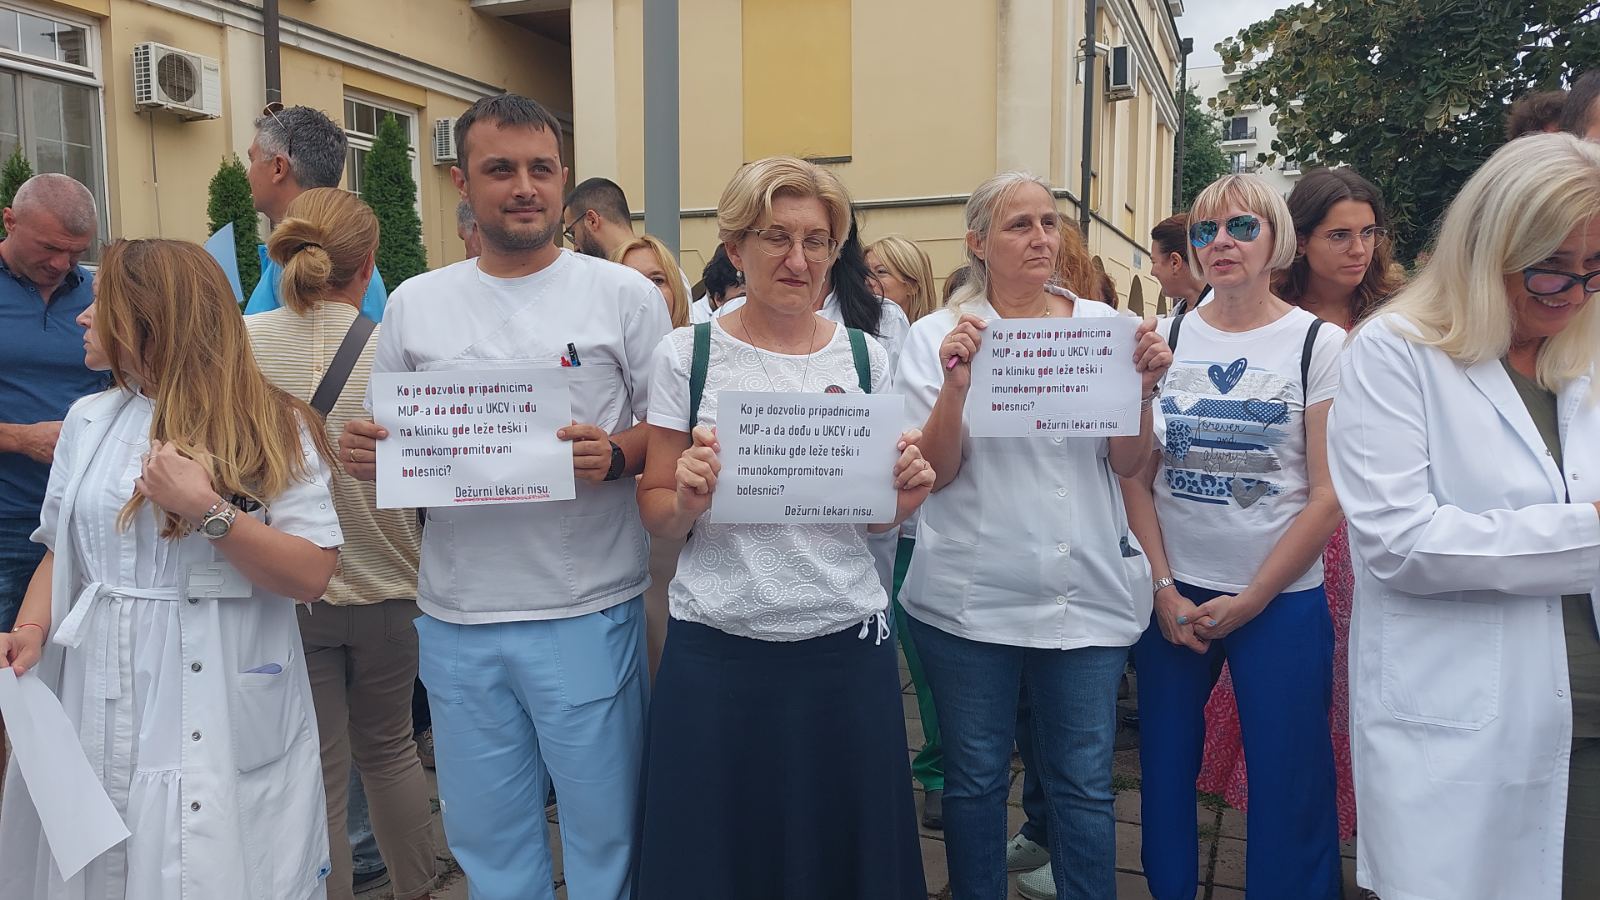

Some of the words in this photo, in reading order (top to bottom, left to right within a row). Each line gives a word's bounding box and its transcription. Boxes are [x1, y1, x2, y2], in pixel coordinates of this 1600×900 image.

[992, 330, 1003, 340] Ko
[1005, 330, 1014, 342] je
[1016, 329, 1051, 339] dozvolio
[1054, 328, 1111, 341] pripadnicima
[992, 348, 1021, 358] MUP-a
[1023, 348, 1034, 358] da
[1036, 347, 1057, 357] dođu
[1067, 346, 1088, 357] UKCV
[1096, 346, 1113, 356] uđu
[992, 368, 1003, 376] na
[1005, 365, 1035, 376] kliniku
[1038, 365, 1053, 377] gde
[1056, 364, 1074, 375] leže
[1076, 364, 1097, 375] teški
[397, 385, 409, 397] Ko
[412, 386, 422, 398] je
[425, 384, 465, 395] dozvolio
[468, 382, 533, 397] pripadnicima
[992, 384, 1088, 395] imunokompromitovani
[398, 405, 431, 417] MUP-a
[434, 404, 446, 415] da
[450, 403, 473, 415] dođu
[477, 405, 483, 414] u
[486, 402, 510, 414] UKCV
[519, 401, 537, 412] uđu
[740, 403, 752, 415] Ko
[755, 405, 764, 418] je
[767, 404, 805, 416] dozvolio
[808, 405, 870, 419] pripadnicima
[992, 401, 1035, 412] bolesnici?
[400, 428, 412, 437] na
[415, 425, 448, 436] kliniku
[452, 424, 470, 438] gde
[473, 422, 494, 434] leže
[497, 421, 521, 433] teški
[739, 424, 771, 436] MUP-a
[774, 425, 786, 436] da
[788, 425, 811, 436] dođu
[814, 428, 820, 436] u
[822, 425, 846, 437] UKCV
[853, 426, 871, 437] uđu
[1036, 419, 1069, 430] Dežurni
[1071, 419, 1097, 429] lekari
[1100, 419, 1120, 429] nisu.
[1195, 416, 1247, 441] forever
[1216, 434, 1235, 445] and
[401, 443, 512, 459] imunokompromitovani
[738, 446, 751, 455] na
[753, 445, 786, 456] kliniku
[789, 445, 806, 458] gde
[809, 445, 828, 456] leže
[831, 445, 854, 456] teški
[402, 465, 452, 477] bolesnici?
[738, 464, 844, 478] imunokompromitovani
[456, 486, 492, 498] Dežurni
[495, 484, 524, 496] lekari
[528, 484, 550, 495] nisu.
[737, 485, 785, 496] bolesnici?
[785, 505, 820, 516] Dežurni
[823, 506, 850, 516] lekari
[852, 506, 874, 516] nisu.
